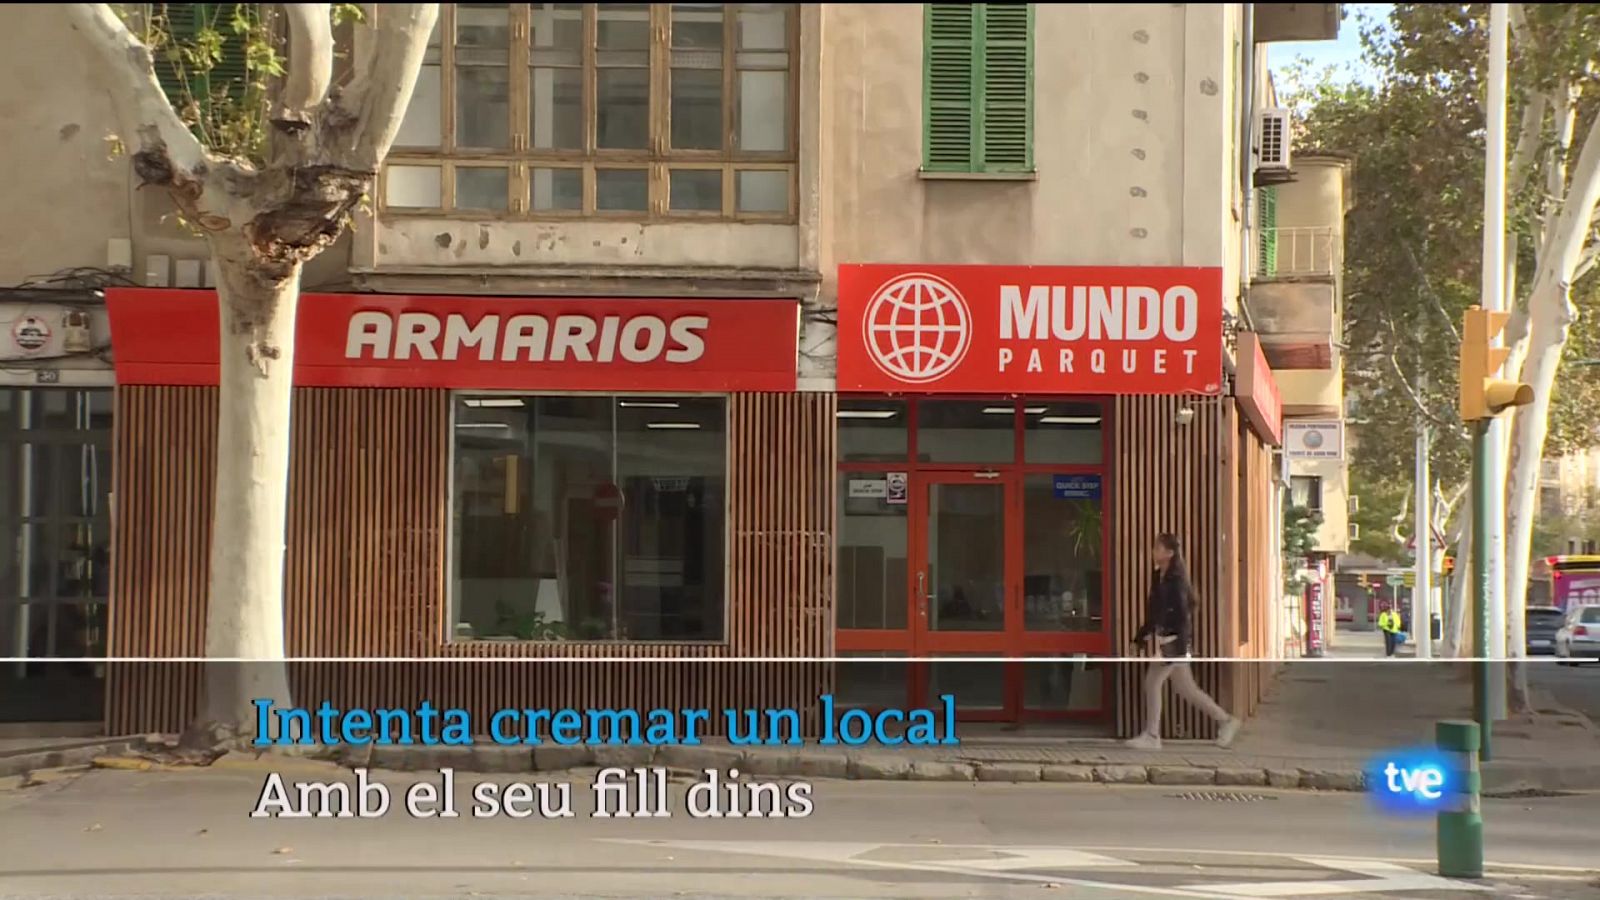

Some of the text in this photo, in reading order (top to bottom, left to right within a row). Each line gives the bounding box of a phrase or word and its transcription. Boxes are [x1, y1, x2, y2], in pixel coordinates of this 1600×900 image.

[344, 310, 710, 363] ARMARIOS
[999, 284, 1199, 342] MUNDO
[998, 347, 1199, 375] PARQUET
